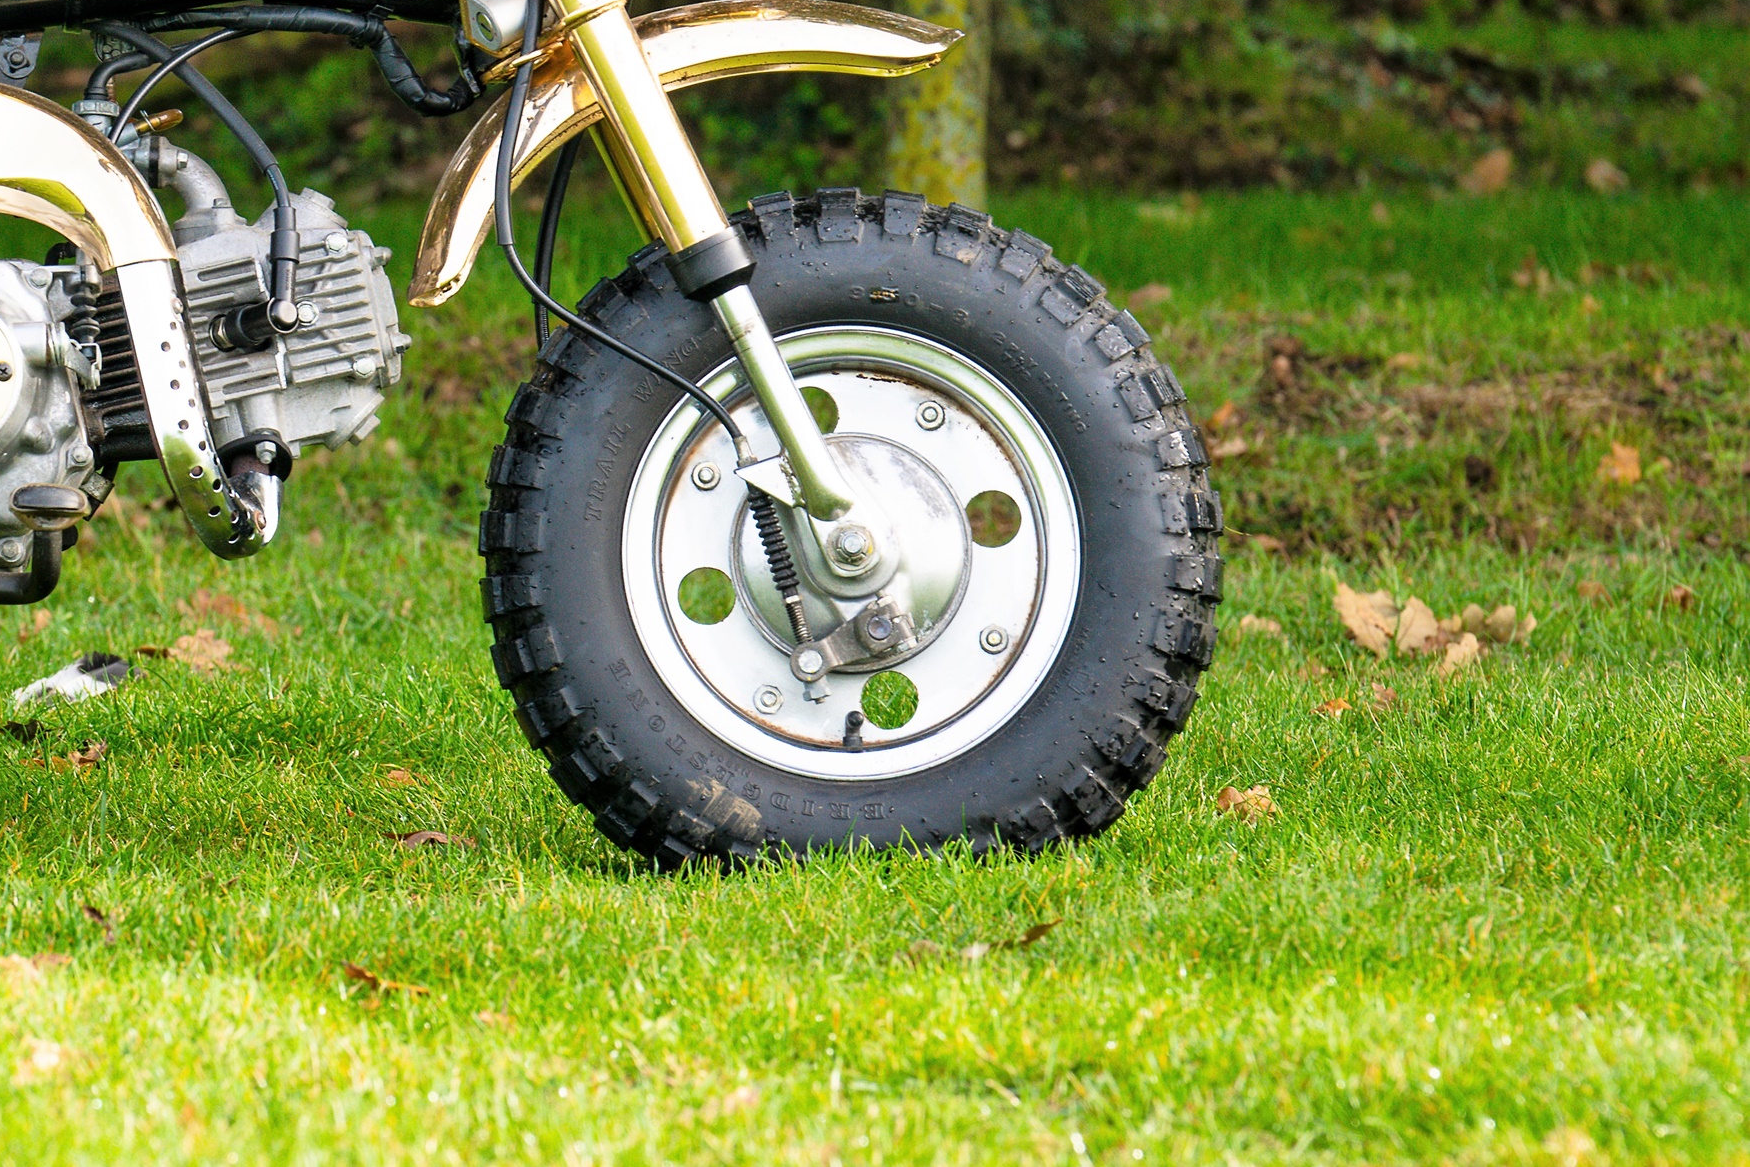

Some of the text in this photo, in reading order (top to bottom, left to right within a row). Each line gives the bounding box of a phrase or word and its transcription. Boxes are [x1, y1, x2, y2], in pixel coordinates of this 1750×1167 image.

[849, 284, 970, 325] 350-8
[585, 420, 631, 522] TRAIL
[608, 657, 886, 820] BRIDGESTONE
